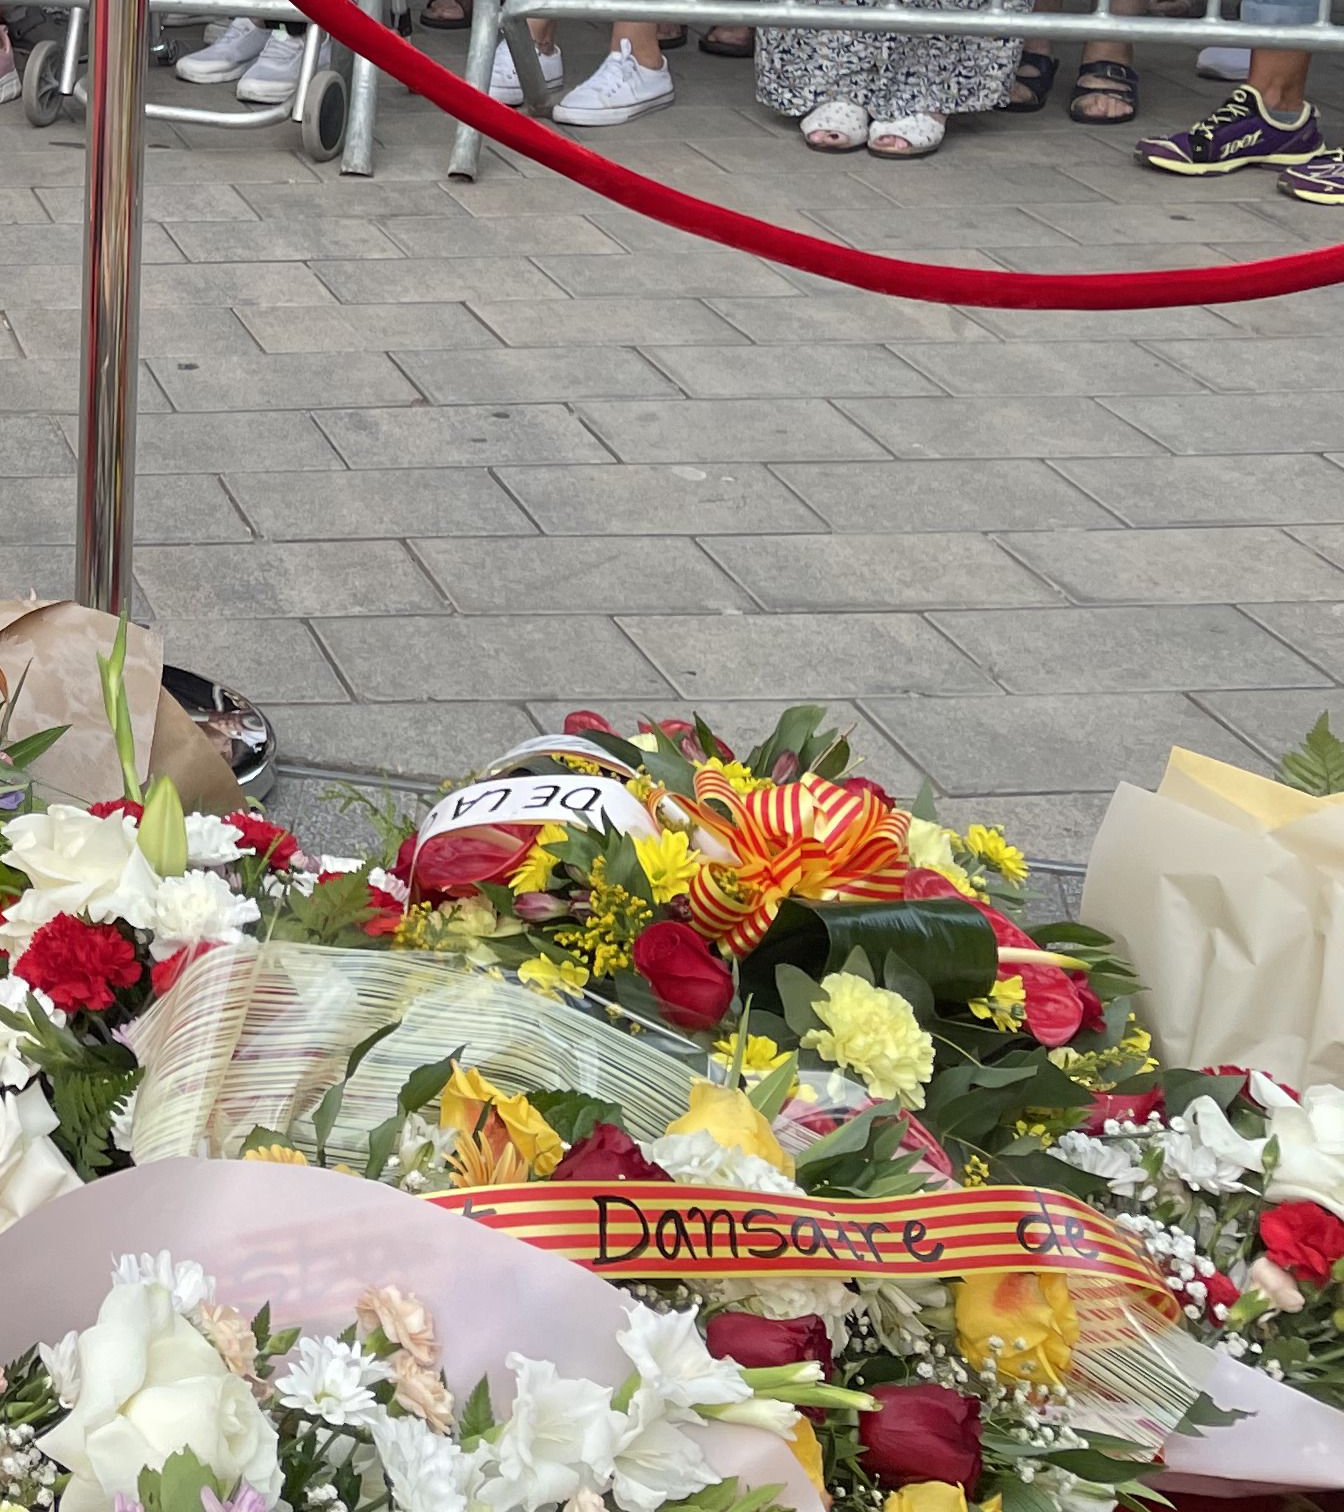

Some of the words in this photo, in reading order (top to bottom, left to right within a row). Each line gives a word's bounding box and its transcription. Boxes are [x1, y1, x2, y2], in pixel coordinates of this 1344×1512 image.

[452, 788, 511, 821] LA
[523, 784, 602, 812] DE
[593, 1194, 944, 1264] Dansaire
[1016, 1189, 1100, 1261] de
